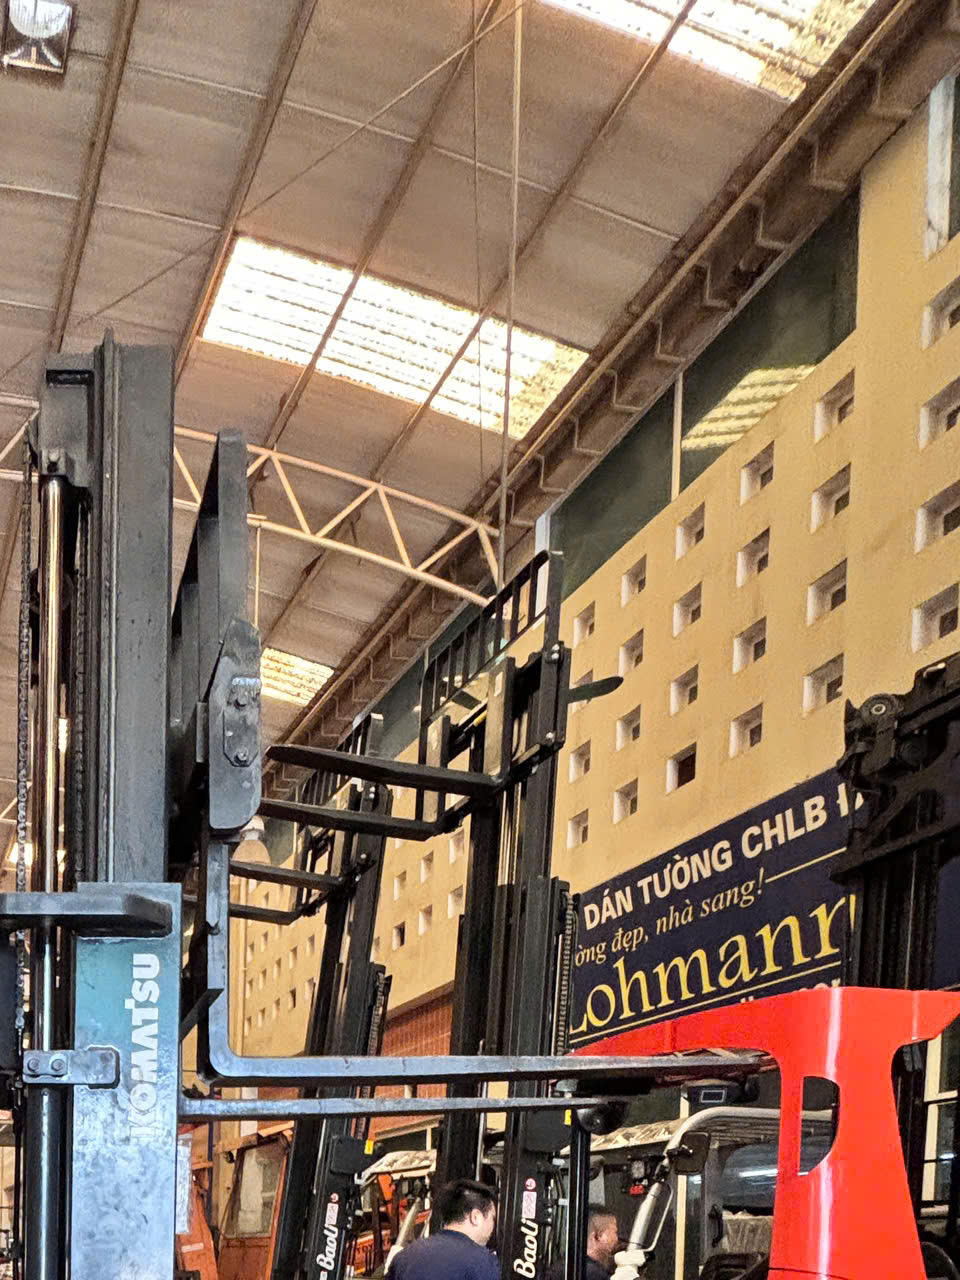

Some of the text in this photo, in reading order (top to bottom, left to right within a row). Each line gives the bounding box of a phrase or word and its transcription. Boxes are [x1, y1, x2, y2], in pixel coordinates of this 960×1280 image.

[583, 886, 634, 930] DÁN
[637, 839, 733, 905] TƯỜNG
[741, 795, 827, 859] CHLB
[656, 904, 694, 936] nhà
[700, 867, 765, 918] sang!
[125, 953, 161, 1139] KOMATSU
[513, 1218, 539, 1279] Baoli
